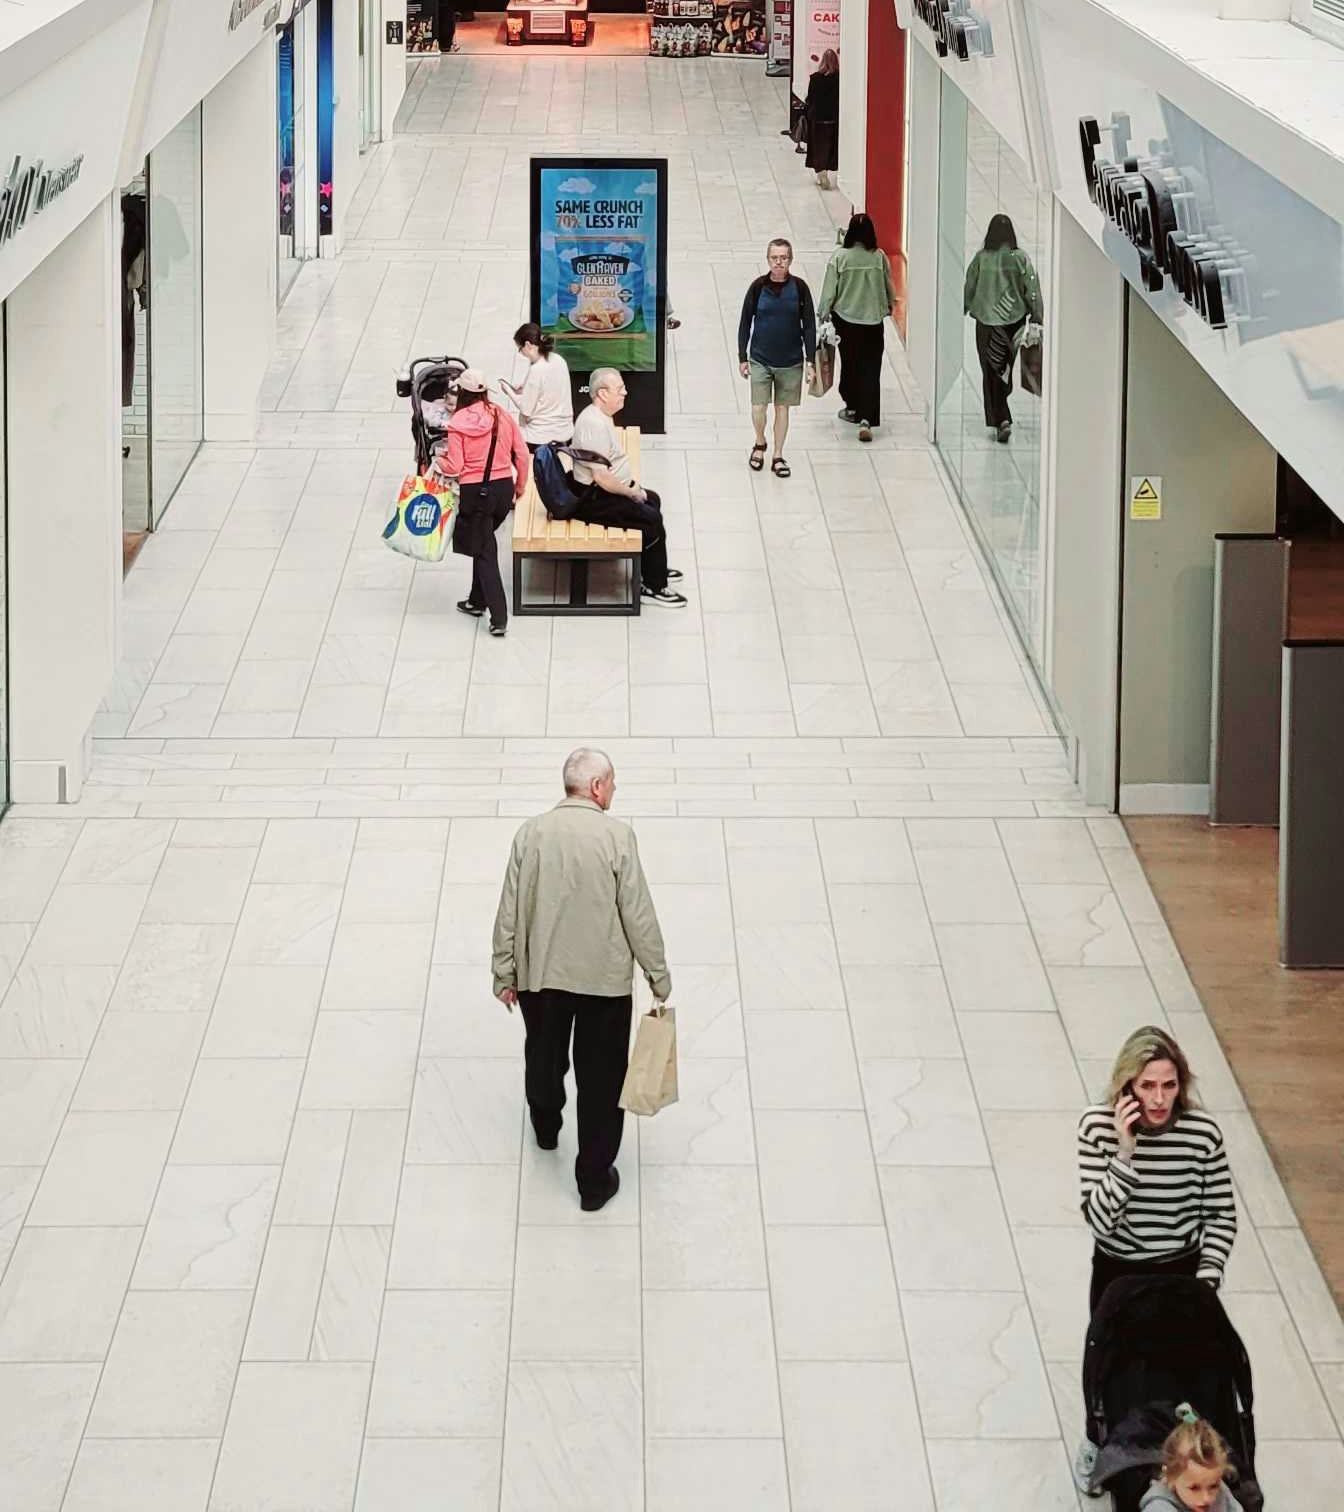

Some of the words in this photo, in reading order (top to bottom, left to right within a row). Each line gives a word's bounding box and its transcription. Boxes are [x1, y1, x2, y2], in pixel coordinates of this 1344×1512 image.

[813, 13, 840, 23] CAK
[555, 200, 590, 213] SAME
[594, 200, 643, 213] CRUNCH
[586, 215, 614, 228] LESS
[617, 215, 641, 228] FAT
[585, 275, 615, 285] BAKED
[578, 385, 590, 393] JC
